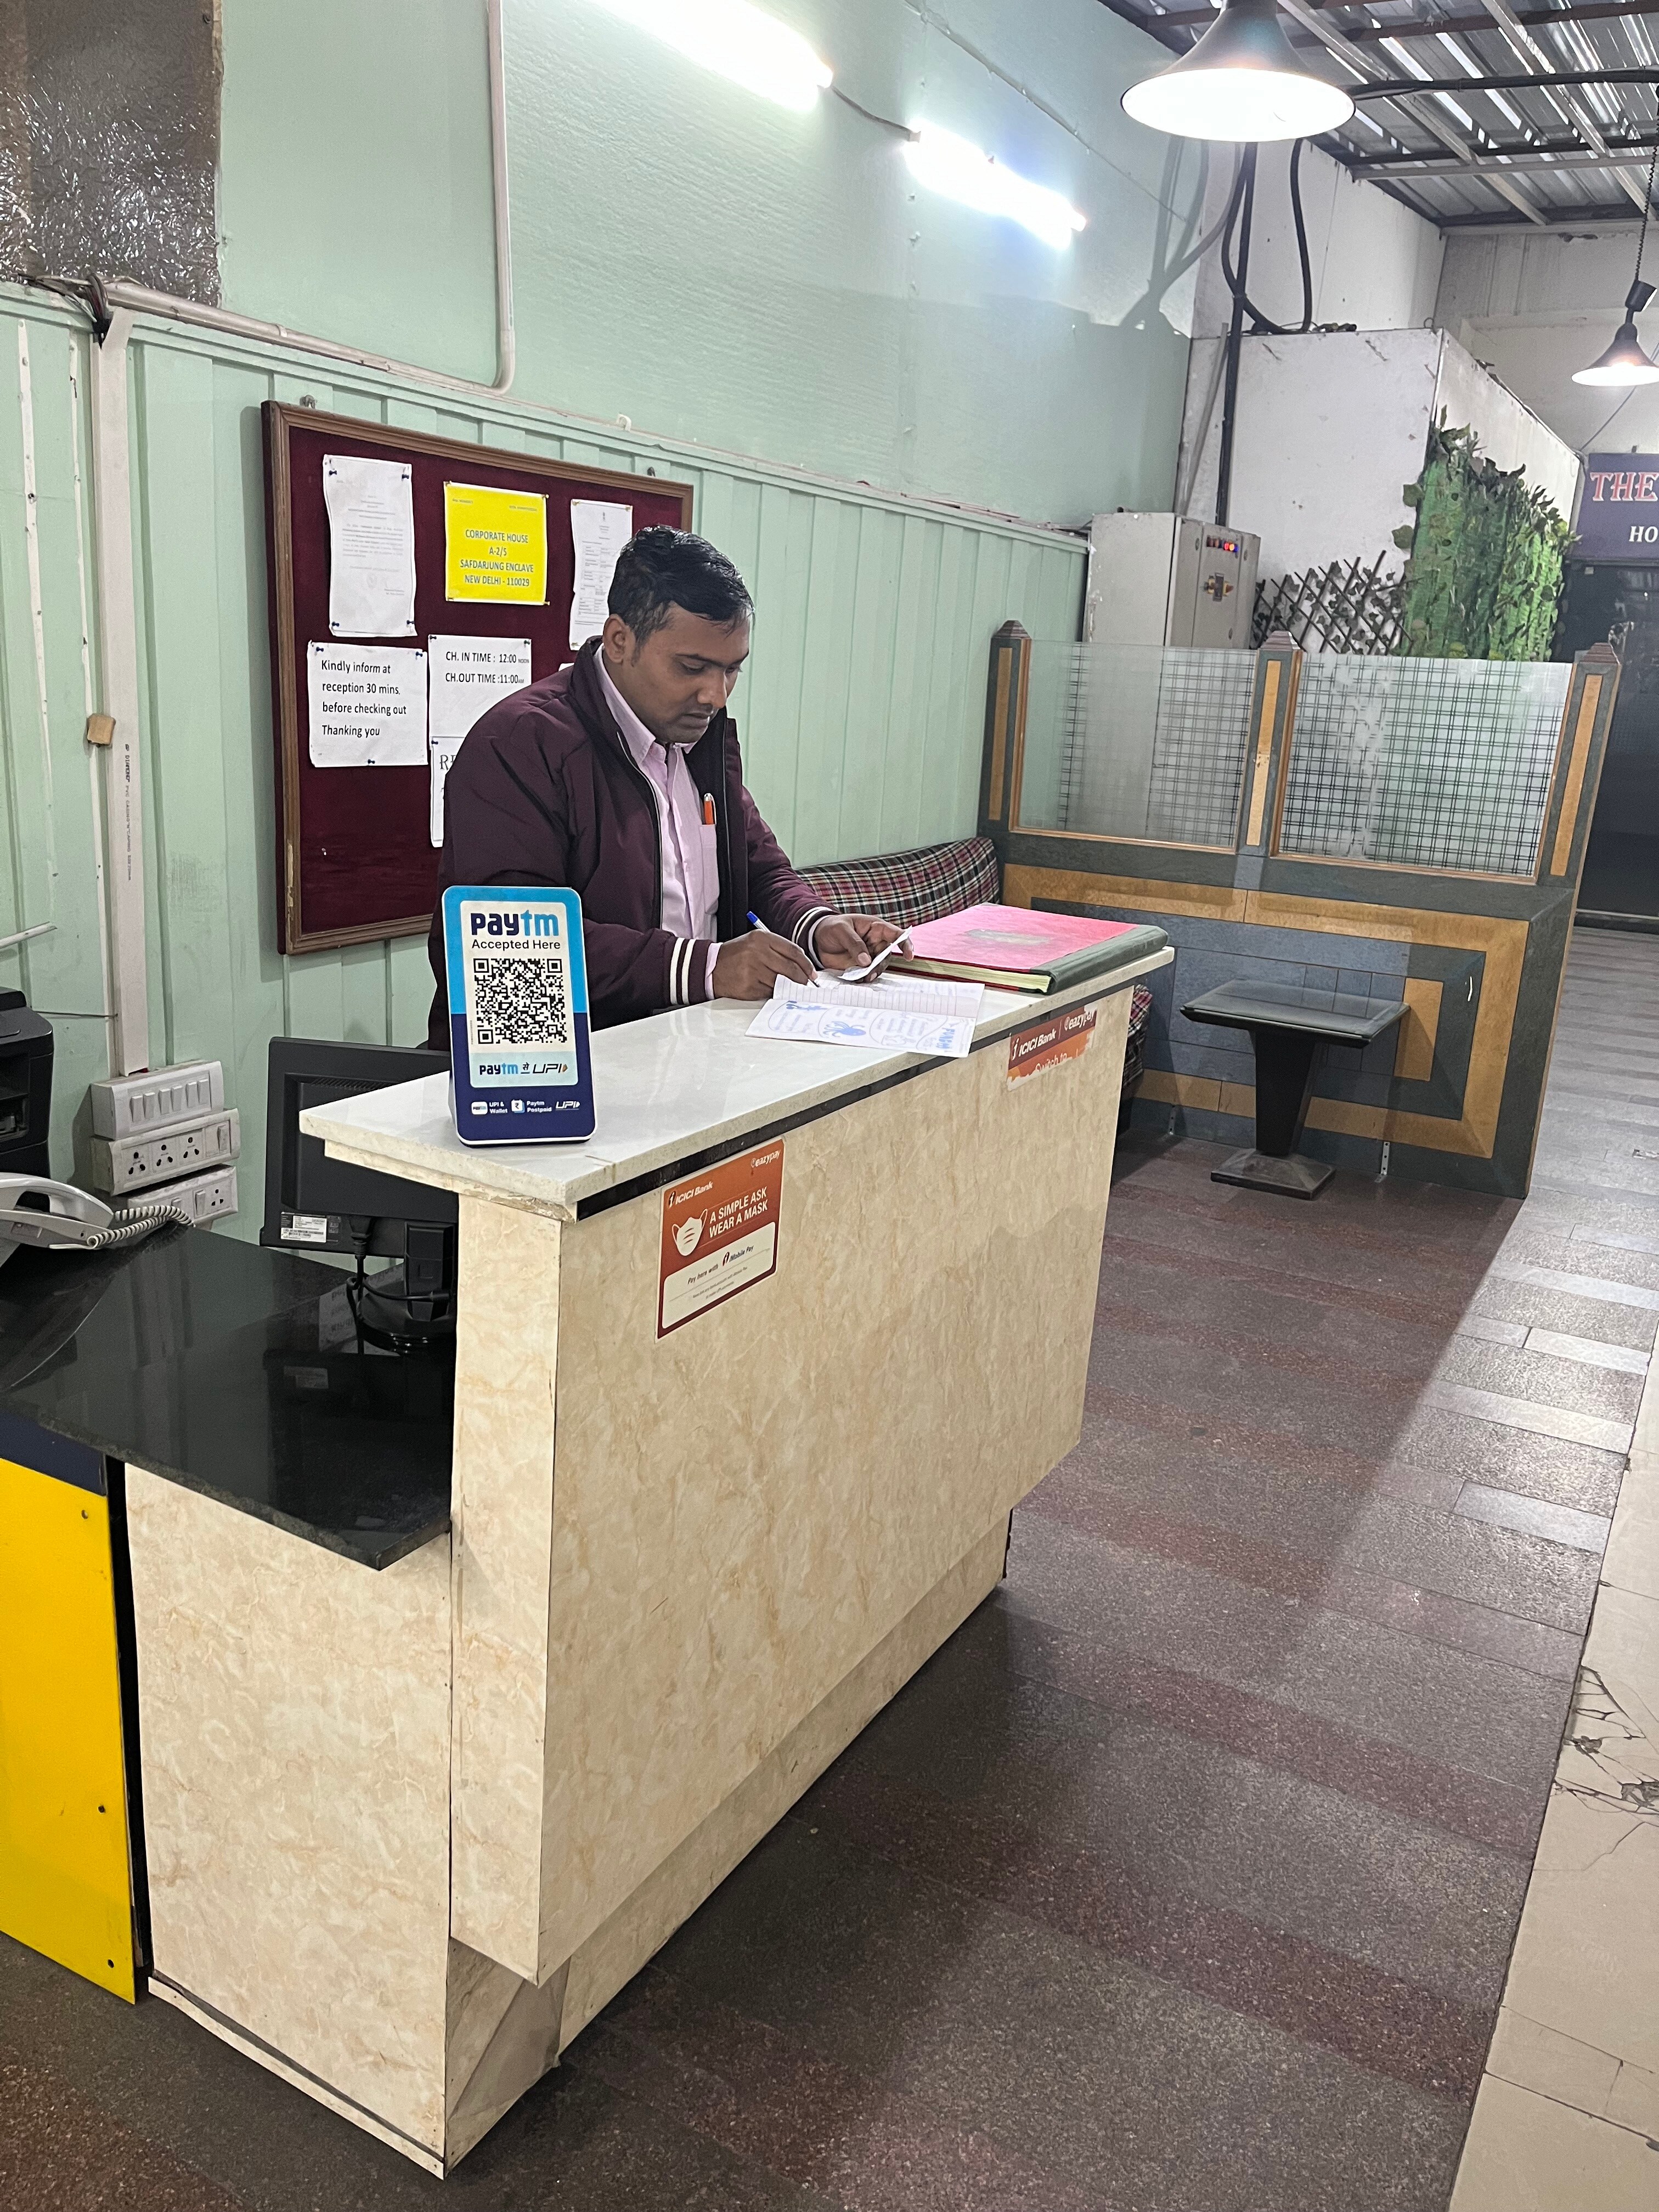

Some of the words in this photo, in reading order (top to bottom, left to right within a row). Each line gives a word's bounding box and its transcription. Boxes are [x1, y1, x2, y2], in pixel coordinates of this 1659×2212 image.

[1590, 472, 1659, 501] THE
[465, 529, 505, 541] CORPORATE
[507, 534, 528, 543] HOUSE
[489, 546, 507, 557] A-2/5
[460, 559, 504, 571] SAFDARJUNG
[506, 562, 534, 573] ENCLAVE
[464, 574, 480, 584] NEW
[482, 576, 501, 585] DELHI
[507, 578, 530, 586] 110029
[445, 651, 459, 661] CH.
[461, 652, 470, 662] IN
[472, 652, 491, 662] TIME
[499, 654, 517, 663] 12:00
[321, 659, 351, 674] Kindly
[353, 662, 380, 673] inform
[382, 665, 391, 674] at
[445, 673, 476, 682] CH.OUT
[477, 674, 496, 683] TIME
[322, 682, 364, 694] reception
[366, 683, 376, 693] 30
[379, 684, 400, 695] mins.
[323, 701, 352, 713] before
[354, 703, 391, 716] checking
[393, 706, 407, 714] out
[321, 725, 362, 738] Thanking
[365, 727, 380, 738] you
[471, 939, 529, 951] Accepted
[533, 940, 561, 950] Here
[1018, 1039, 1037, 1057] ICICI
[1037, 1028, 1057, 1047] Bank
[532, 1063, 563, 1074] UPI
[755, 1150, 781, 1167] eazypay
[675, 1189, 695, 1205] ICICI
[694, 1181, 713, 1196] Bank
[709, 1211, 716, 1224] A
[718, 1195, 749, 1220] SIMPLE
[750, 1186, 768, 1205] ASK
[709, 1216, 734, 1238] WEAR
[736, 1212, 742, 1226] A
[744, 1199, 768, 1221] MASK
[687, 1277, 696, 1285] Pay
[697, 1270, 708, 1280] here
